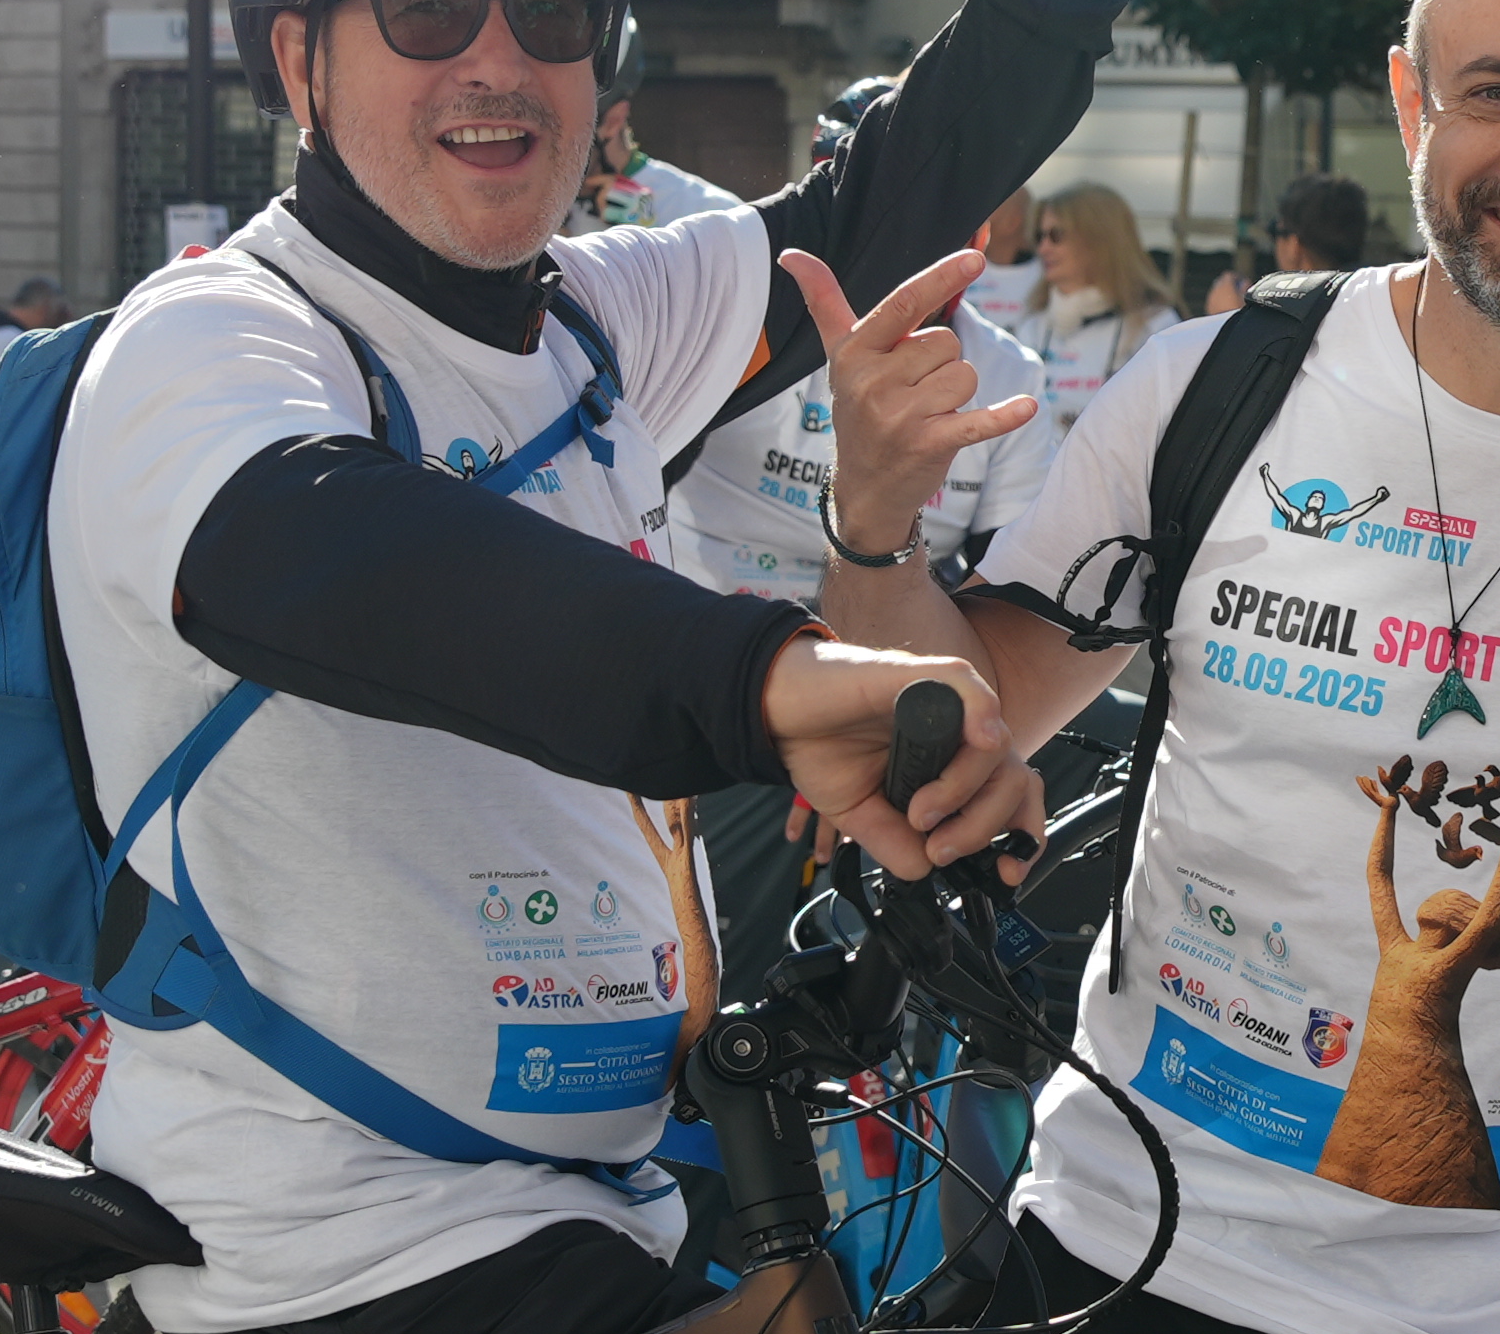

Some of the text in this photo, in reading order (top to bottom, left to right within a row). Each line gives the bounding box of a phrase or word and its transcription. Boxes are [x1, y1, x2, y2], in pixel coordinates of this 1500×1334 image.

[1408, 509, 1473, 538] SPECIAL
[1355, 521, 1472, 567] SPORT DAY
[1210, 579, 1358, 657] SPECIAL
[1203, 640, 1386, 717] 28.09.2025
[1008, 928, 1031, 947] 532
[487, 948, 567, 962] LOMBARDIA
[1164, 935, 1232, 974] LOMBARDIA
[533, 978, 555, 993] AD
[597, 981, 649, 1000] FIORANI
[1185, 977, 1205, 996] AD
[528, 993, 585, 1009] ASTRA
[1182, 992, 1221, 1024] ASTRA
[1233, 1011, 1290, 1047] FIORANI
[66, 1067, 95, 1103] Vostri
[558, 1073, 595, 1086] SESTO
[597, 1070, 619, 1084] SAN
[1186, 1076, 1304, 1140] SESTO SAN GIOVANNI
[1252, 1097, 1267, 1112] DI
